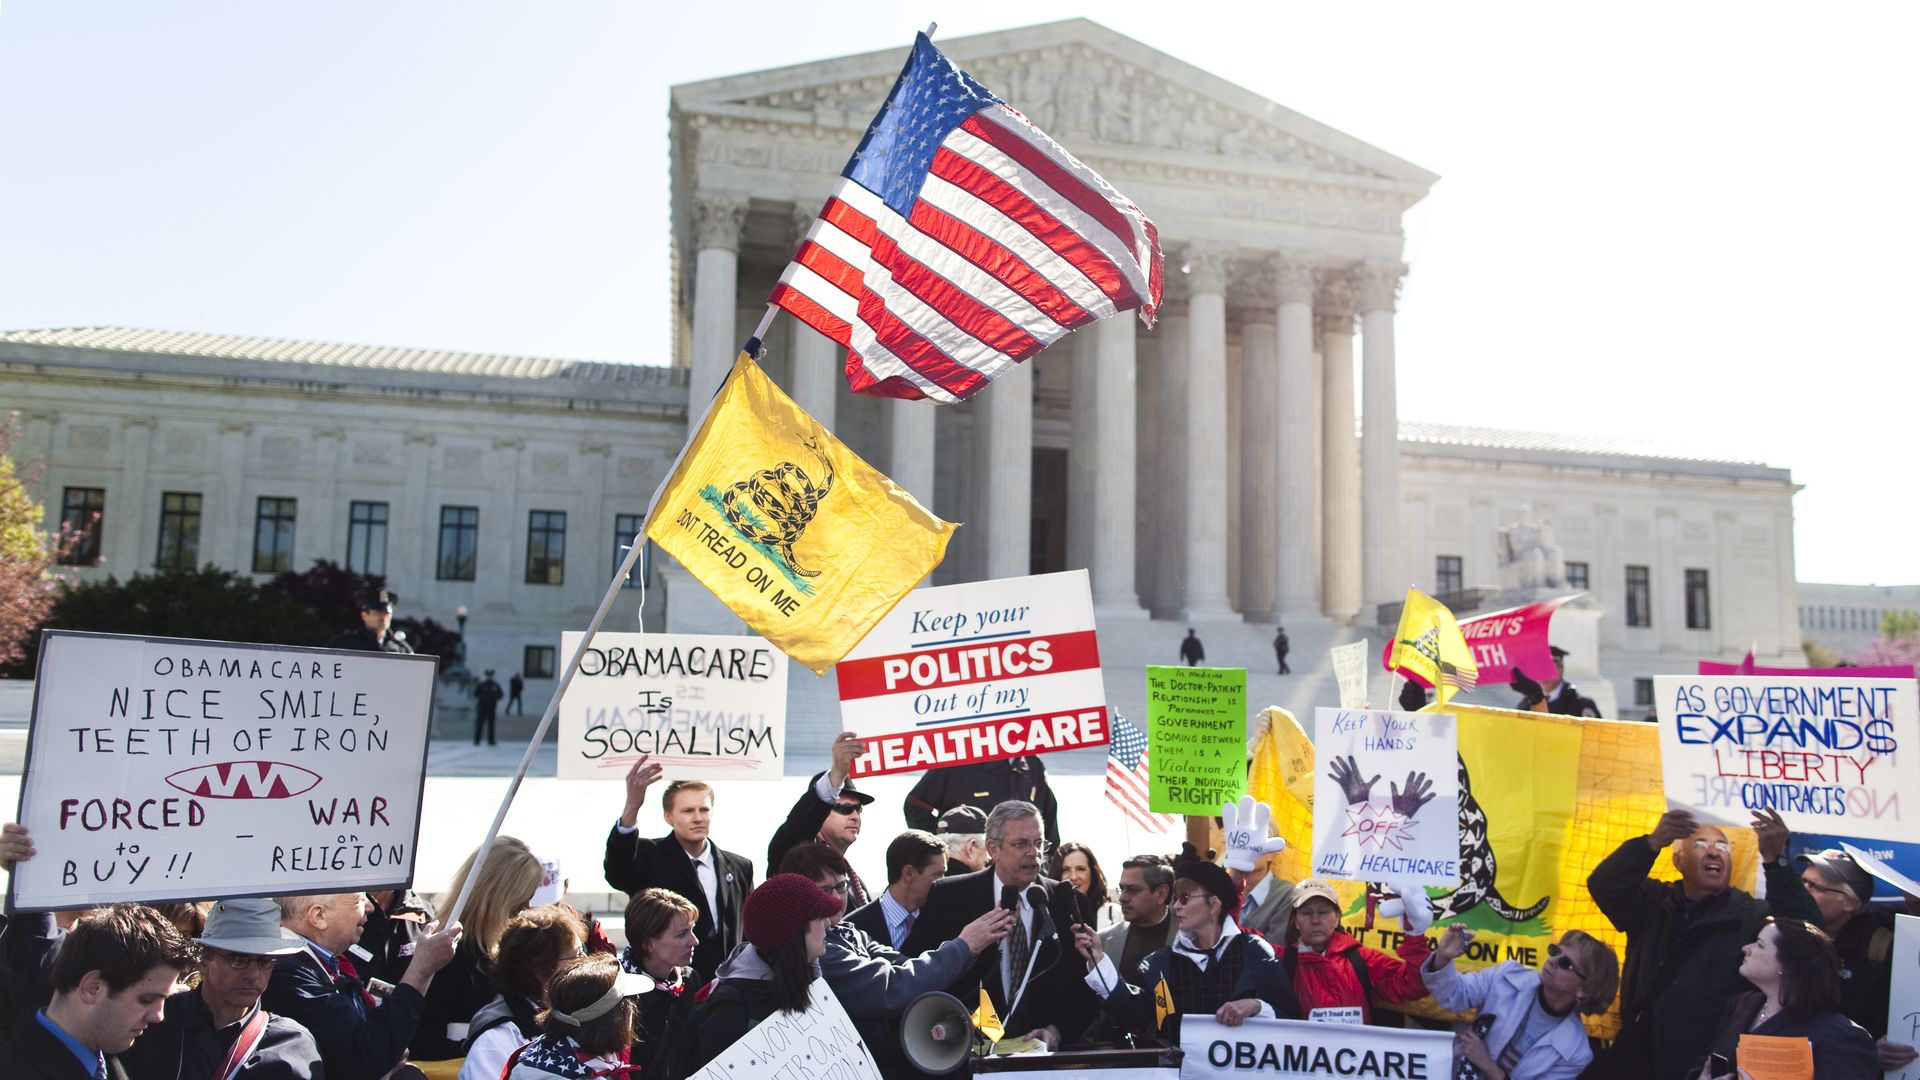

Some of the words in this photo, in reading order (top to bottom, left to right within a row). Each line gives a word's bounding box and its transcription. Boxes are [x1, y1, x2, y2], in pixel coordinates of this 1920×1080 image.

[696, 523, 748, 569] TREAD
[746, 567, 774, 593] ON
[770, 589, 801, 618] ME
[911, 610, 967, 637] Keep
[975, 605, 1029, 634] your
[154, 656, 343, 679] OBAMACARE
[578, 646, 769, 680] OBAMACARE
[883, 640, 1053, 690] POLITICS
[1150, 678, 1166, 689] THE
[109, 687, 224, 721] NICE
[258, 689, 381, 726] SMILE,
[914, 692, 956, 716] Out
[967, 684, 992, 713] of
[995, 686, 1029, 709] my
[1152, 692, 1217, 704] RELATIONSHIP
[1675, 685, 1706, 712] AS
[1714, 686, 1897, 719] GOVERNMENT
[1157, 716, 1236, 730] GOVERNMENT
[1332, 712, 1368, 735] KEEP
[1382, 715, 1418, 737] YOUR
[69, 728, 211, 756] TEETH
[233, 728, 272, 752] OF
[290, 728, 389, 752] IRON
[581, 725, 777, 759] SOCIALISM
[854, 711, 1104, 774] HEALTHCARE
[1156, 731, 1197, 744] COMING
[1202, 735, 1241, 744] BETWEEN
[1156, 745, 1184, 755] THEM
[1365, 736, 1416, 751] HANDS
[1158, 759, 1221, 775] Violation
[1226, 760, 1240, 777] of
[1716, 748, 1874, 785] LIBERTY
[1156, 775, 1189, 786] THEIR
[1195, 777, 1240, 790] INDIVIDUAL
[1168, 786, 1236, 806] RIGHTS
[308, 796, 390, 828] WAR
[1742, 783, 1845, 816] CONTRACTS
[59, 797, 206, 832] FORCED
[1358, 818, 1399, 834] OFF
[115, 842, 140, 857] to
[337, 834, 358, 843] on
[271, 843, 404, 873] RELIGION
[1360, 853, 1456, 878] HEALTHCARE
[1466, 941, 1499, 963] ON
[1506, 945, 1538, 966] ME
[807, 1018, 854, 1066] OWN
[1207, 1039, 1428, 1080] OBAMACARE
